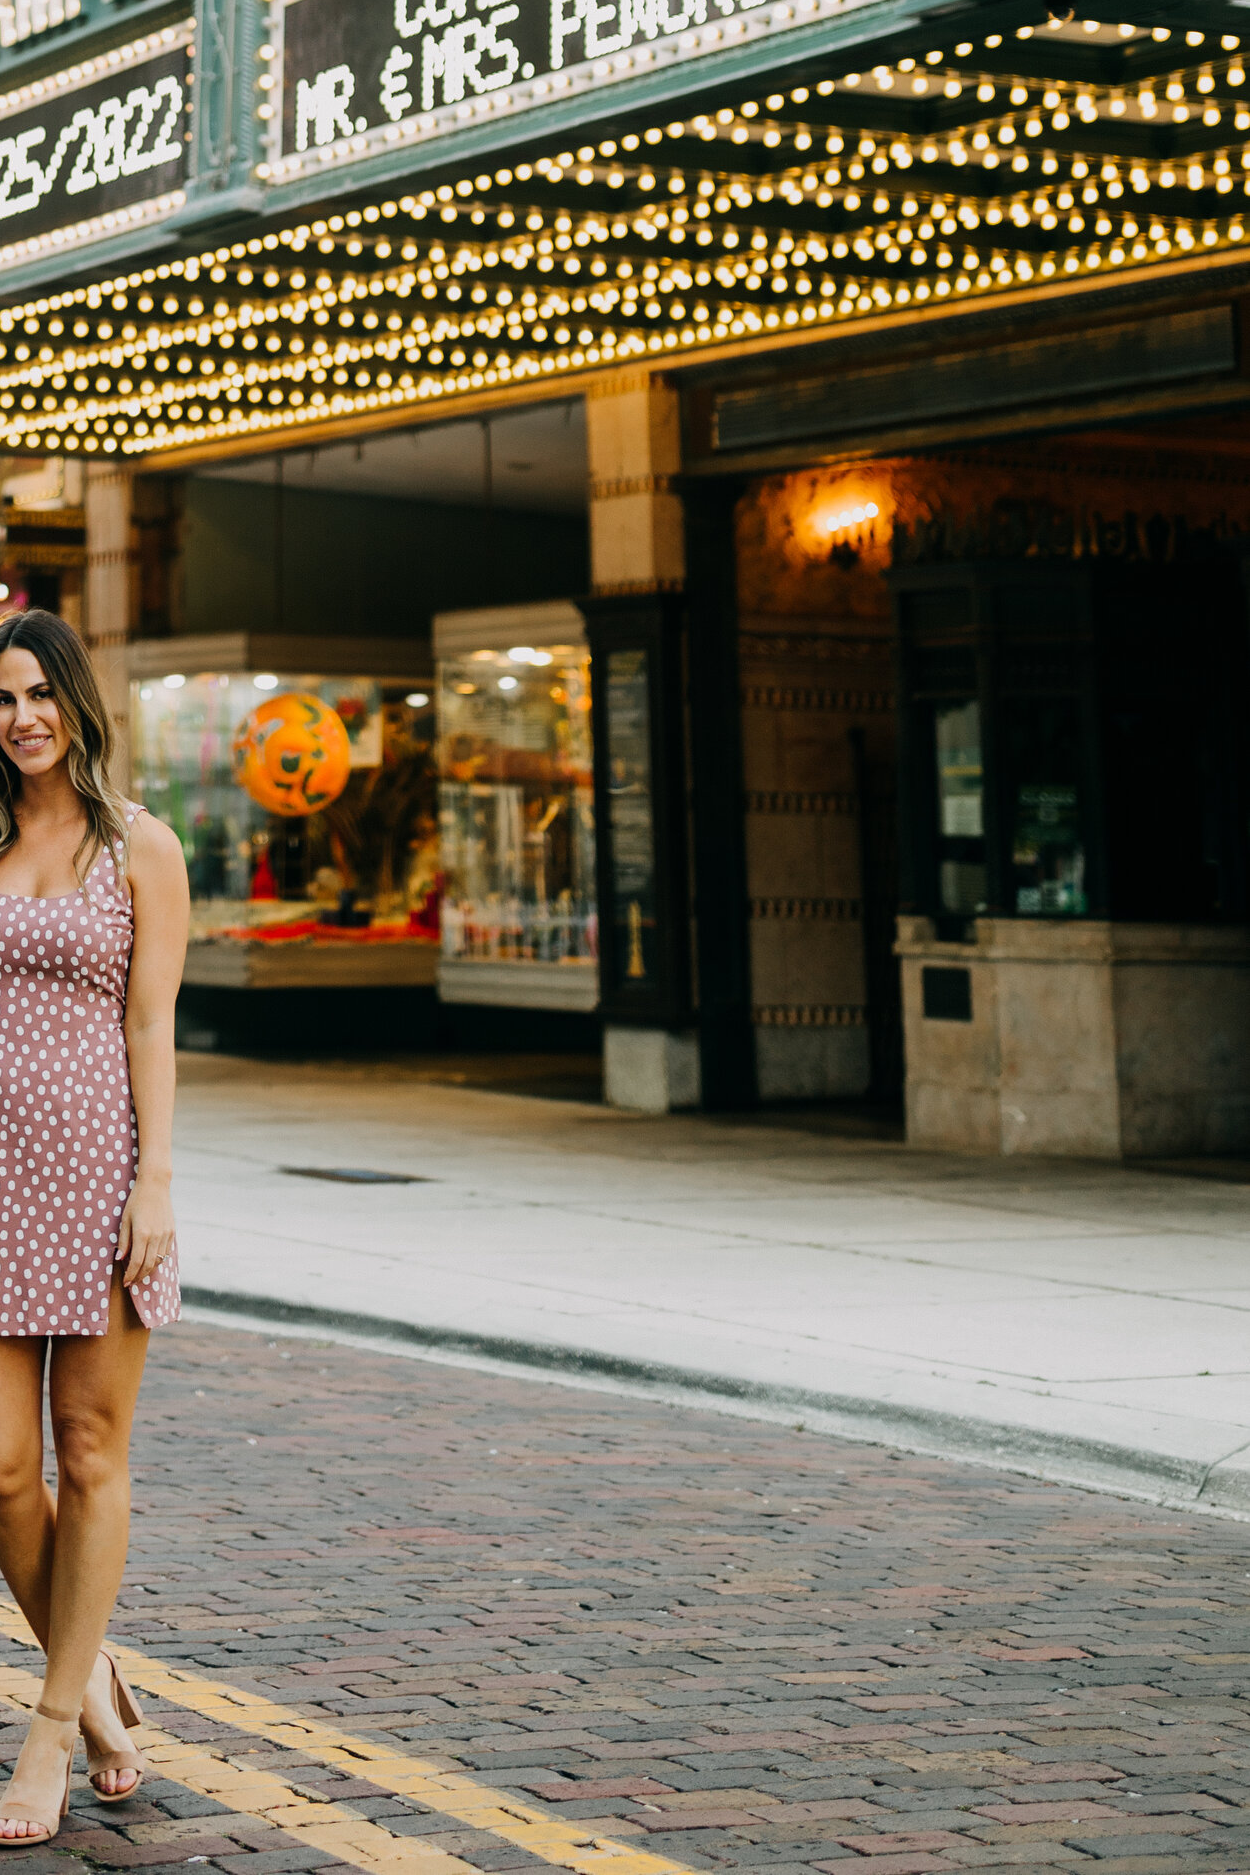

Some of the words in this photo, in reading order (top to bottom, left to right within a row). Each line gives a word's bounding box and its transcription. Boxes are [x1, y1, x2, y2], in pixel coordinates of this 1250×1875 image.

[295, 63, 368, 151] MR.
[380, 44, 412, 121] &
[421, 3, 536, 110] MRS.
